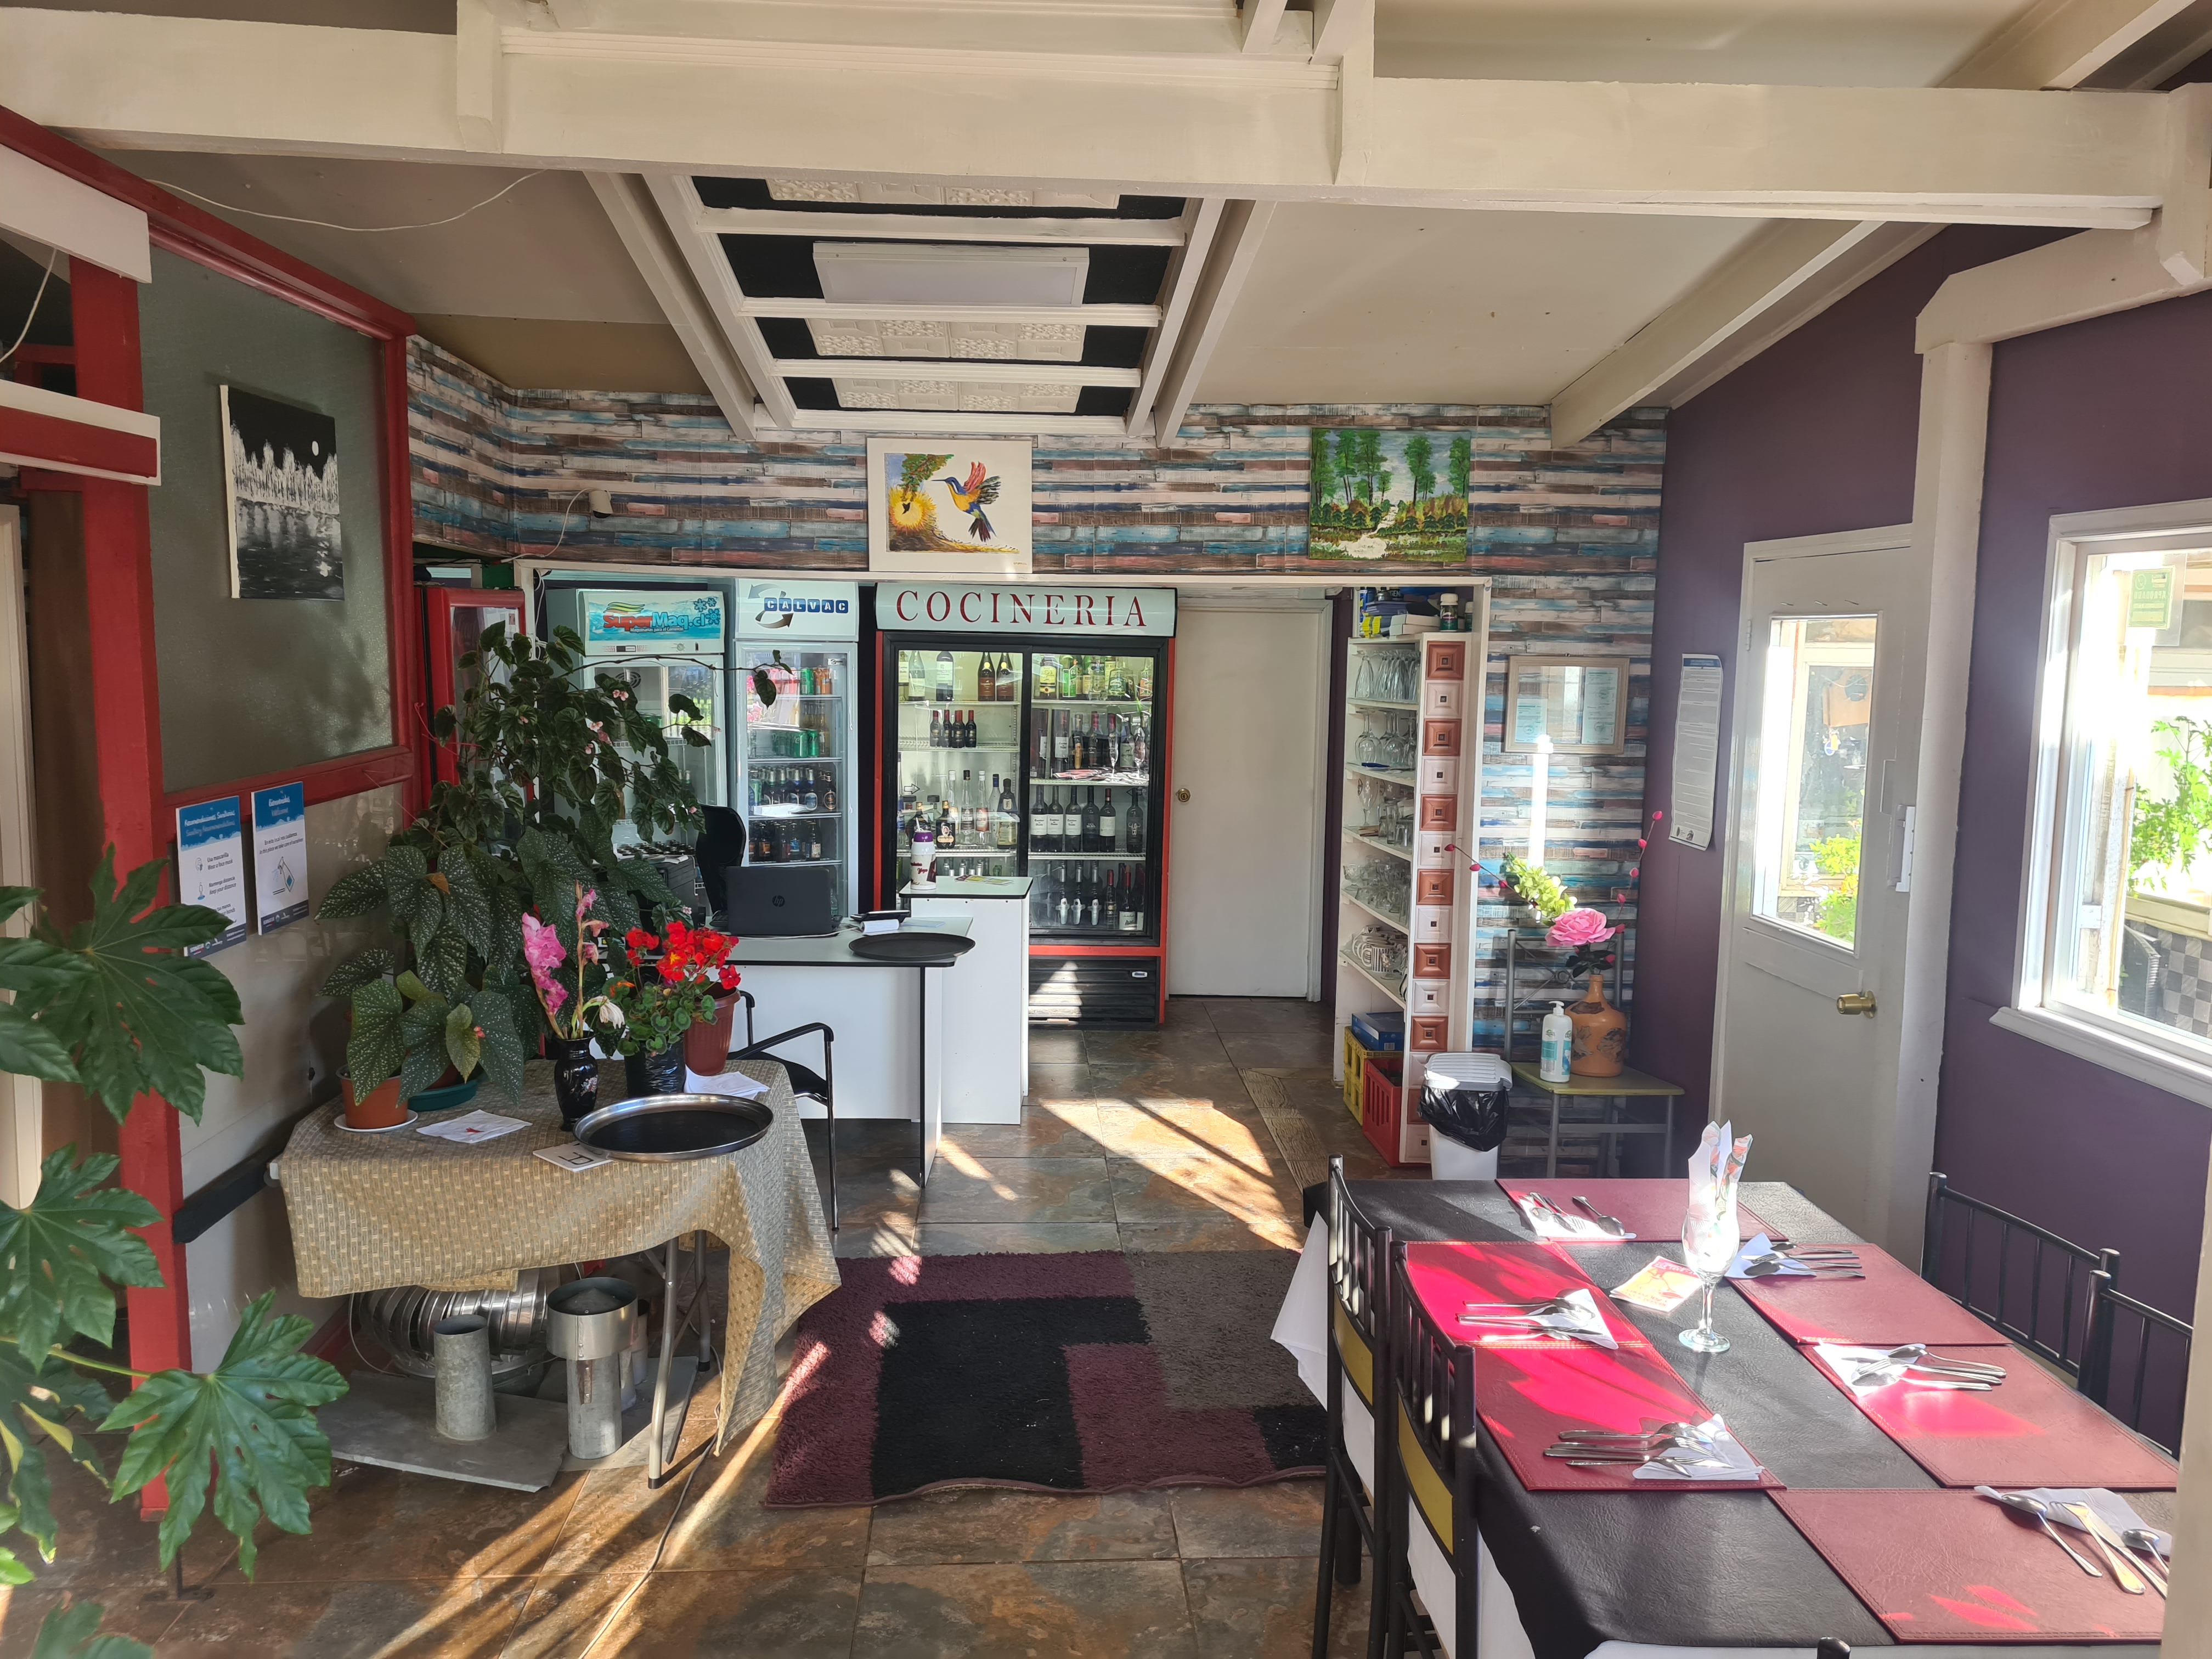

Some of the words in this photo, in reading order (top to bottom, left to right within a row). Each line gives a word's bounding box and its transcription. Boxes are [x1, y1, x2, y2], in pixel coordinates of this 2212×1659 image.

[766, 600, 846, 612] CALVAC
[896, 590, 1147, 627] COCINERIA
[774, 895, 784, 907] hp
